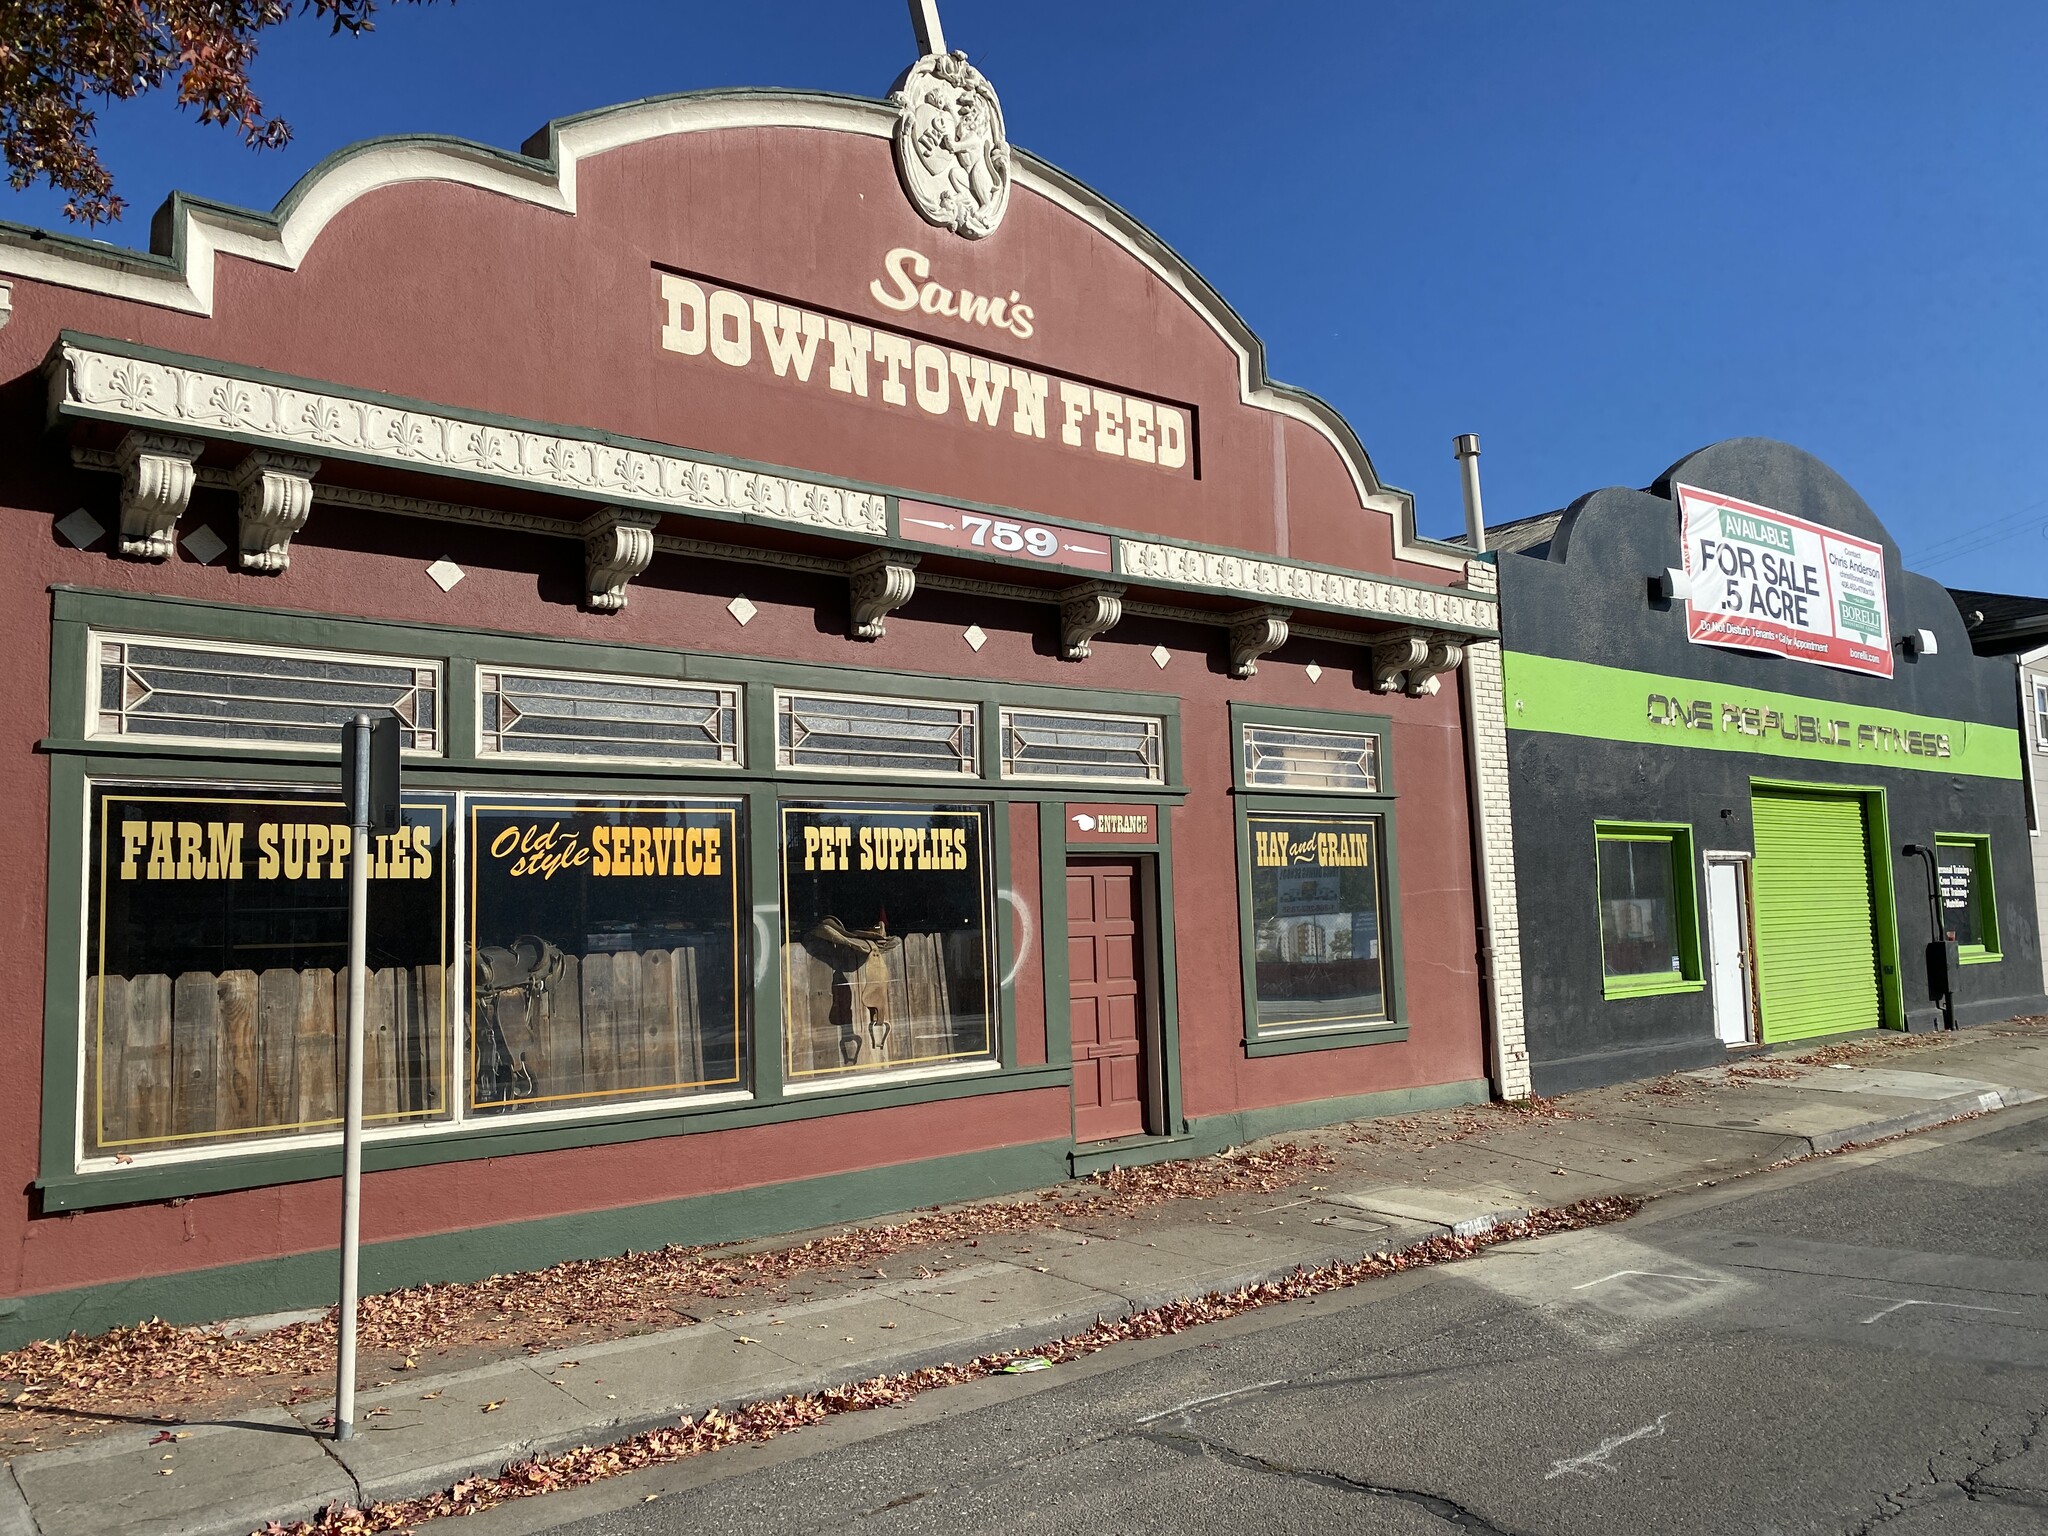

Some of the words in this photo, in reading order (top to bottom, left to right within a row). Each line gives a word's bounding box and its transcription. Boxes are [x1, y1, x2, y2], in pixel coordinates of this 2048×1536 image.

[870, 248, 1035, 340] Sam's
[661, 274, 1049, 440] DOWNTOWN
[1060, 381, 1187, 469] FEED
[961, 515, 1059, 558] 759
[1726, 515, 1791, 549] AVAILABLE
[1700, 539, 1758, 581] FOR
[1762, 553, 1820, 597] SALE
[1829, 553, 1848, 569] Chris
[1849, 561, 1880, 579] Anderson
[1722, 579, 1743, 611] .5
[1749, 583, 1809, 627] ACRE
[1841, 604, 1880, 627] BORELLI
[1700, 619, 1711, 632] Do
[1727, 623, 1751, 637] Disturb
[1751, 626, 1775, 640] Tenants
[1850, 647, 1880, 664] borelli.com
[1647, 693, 1714, 731] ONE
[1721, 702, 1851, 746] REPUBLIC
[1857, 724, 1951, 758] FITNESS
[1097, 814, 1148, 833] ENTRANCE
[121, 820, 244, 880] FARM
[258, 822, 433, 880] SUPPIES
[510, 840, 590, 881] style
[592, 825, 721, 877] SERVICE
[804, 826, 851, 870] PET
[859, 826, 967, 870] SUPPLIES
[1255, 831, 1289, 867] HAY
[1289, 831, 1317, 857] and
[1317, 831, 1368, 867] GRAIN
